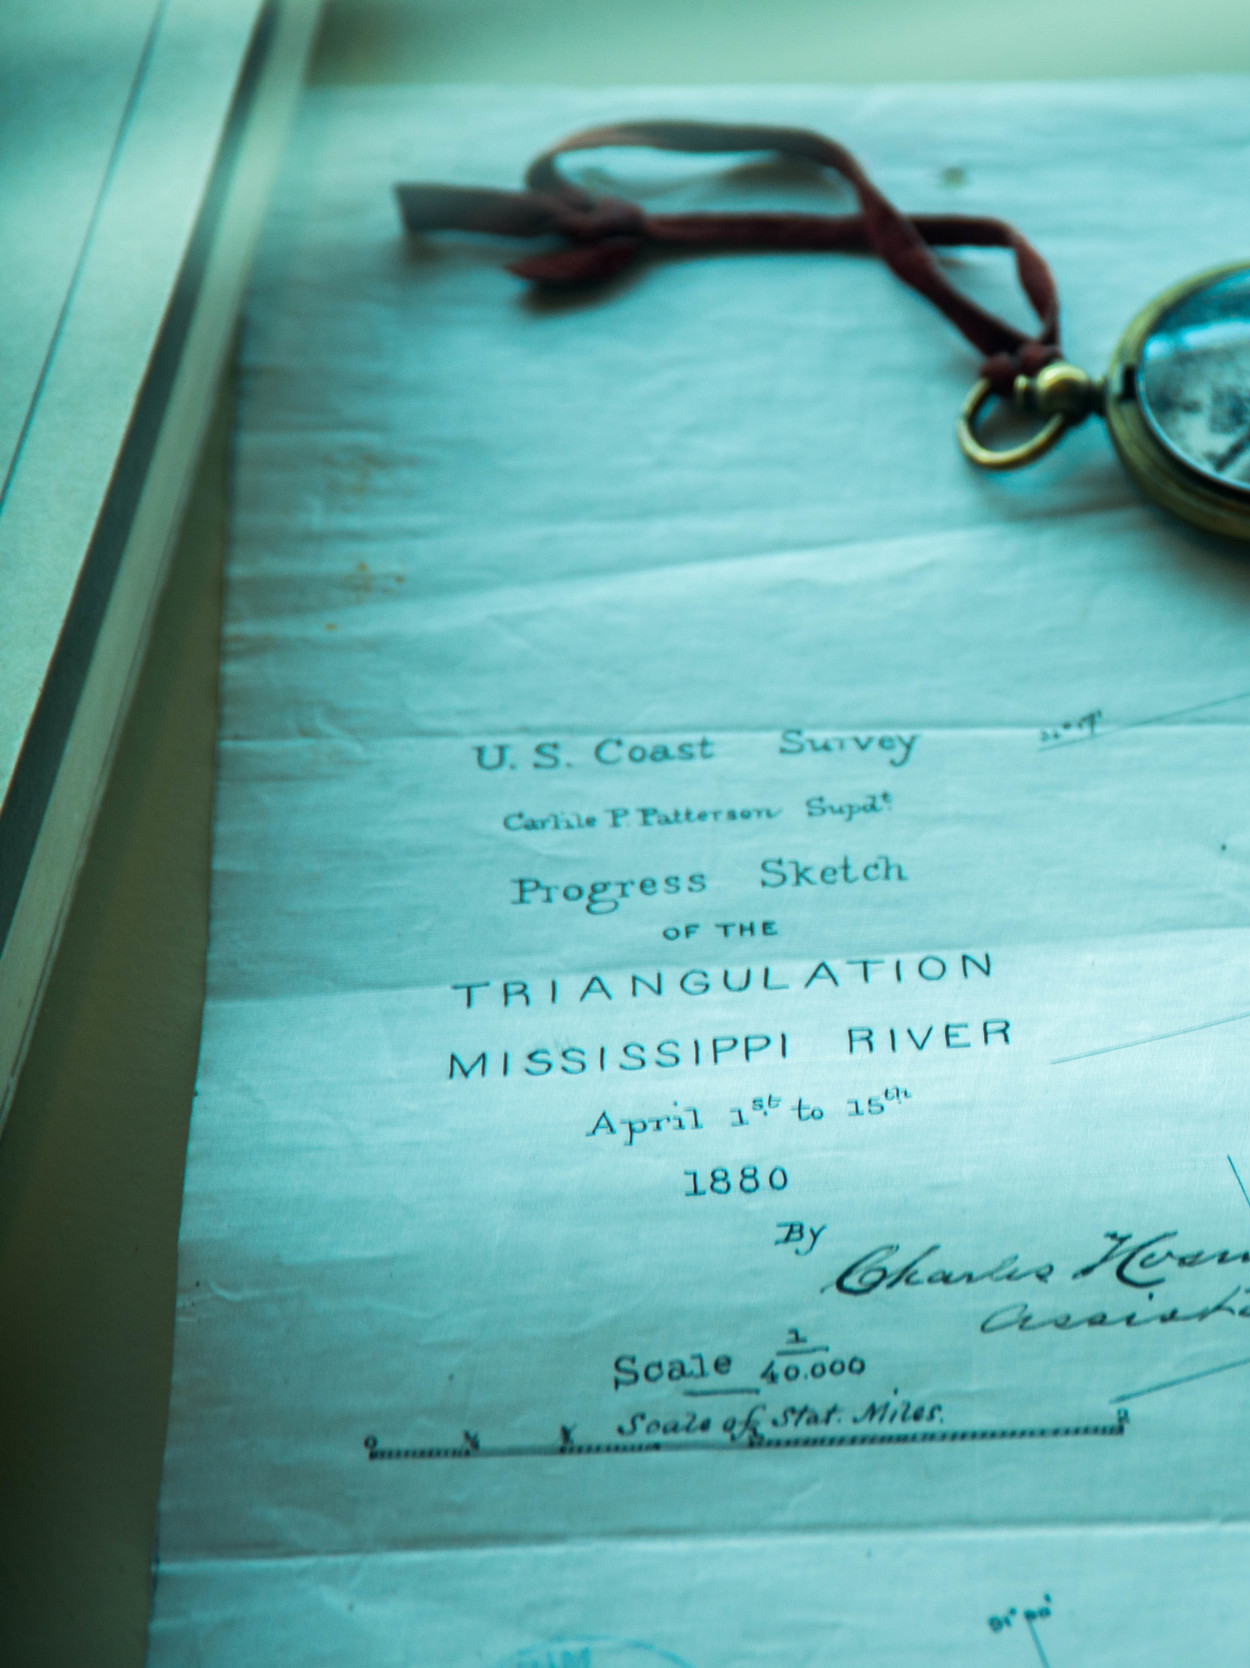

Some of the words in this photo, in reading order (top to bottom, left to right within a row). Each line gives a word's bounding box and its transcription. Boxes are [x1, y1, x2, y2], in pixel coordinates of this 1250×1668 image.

[473, 744, 517, 770] U.
[532, 742, 572, 770] S.
[594, 737, 715, 764] Coast
[779, 729, 917, 767] Survey
[635, 805, 783, 827] Patterson
[510, 872, 708, 916] Progress
[760, 854, 909, 889] Sketch
[662, 923, 700, 941] OF
[714, 920, 779, 939] THE
[450, 952, 993, 1008] TRIANGULATION
[448, 1032, 788, 1080] MISSISSIPPI
[847, 1018, 1013, 1056] RIVER
[585, 1100, 704, 1147] April
[791, 1097, 825, 1122] to
[683, 1164, 790, 1198] 1880
[774, 1221, 828, 1257] By
[820, 1244, 1055, 1296] Charles
[613, 1353, 732, 1391] Scale
[616, 1411, 711, 1436] Scale
